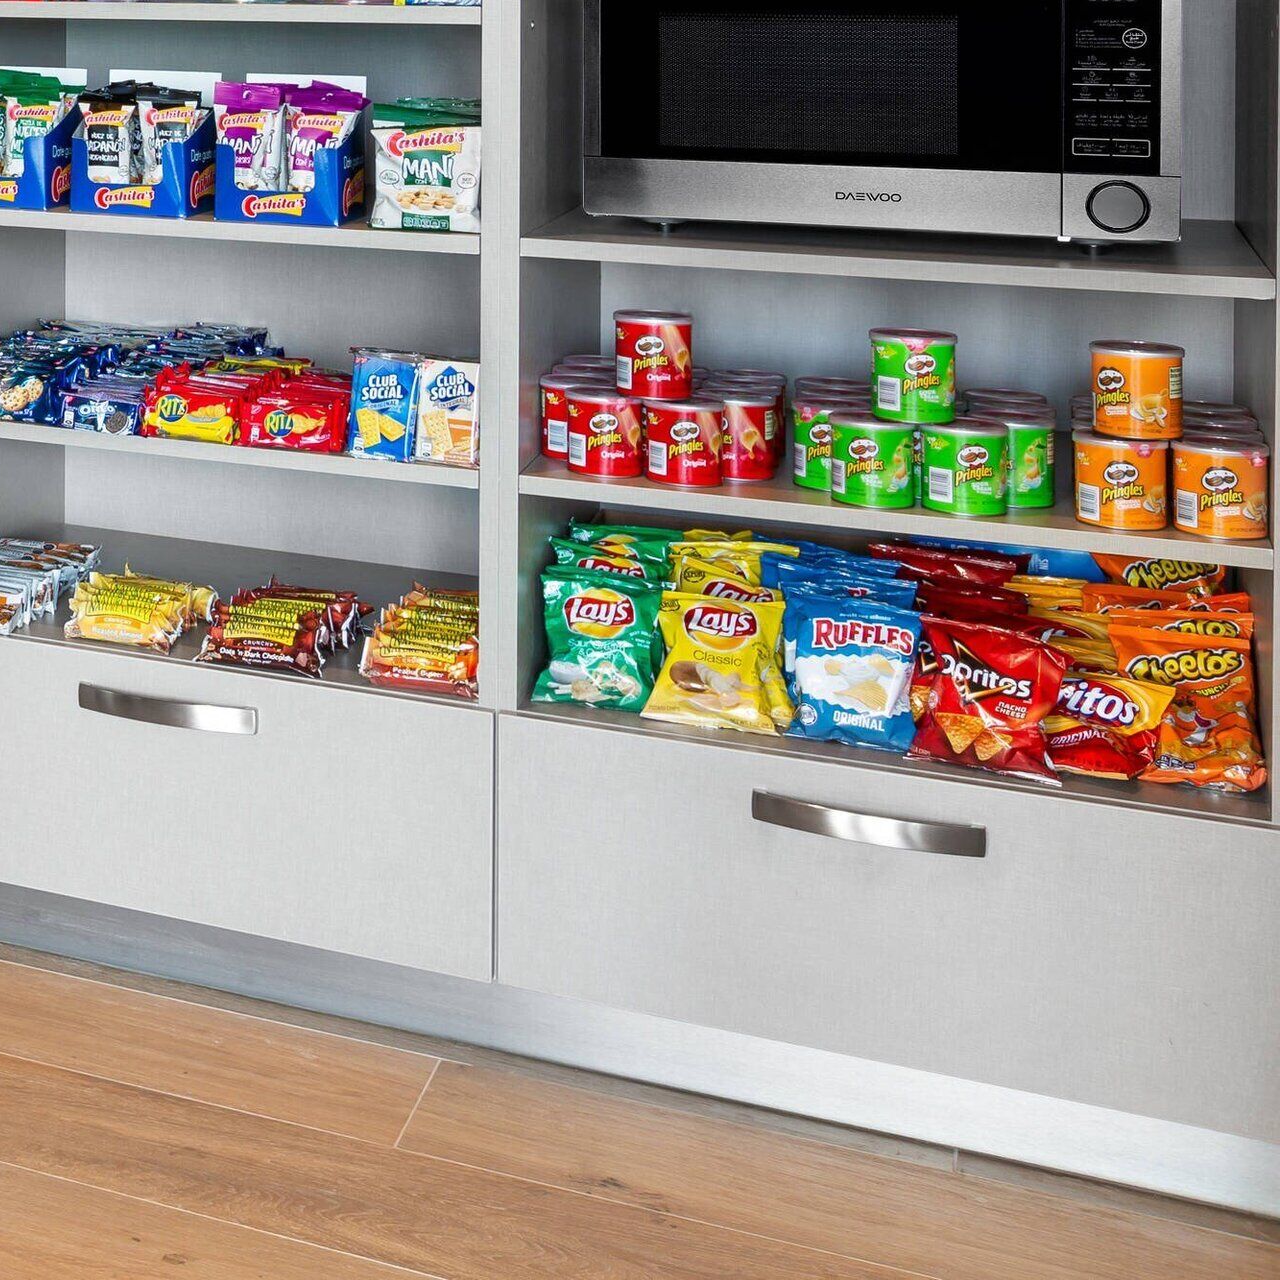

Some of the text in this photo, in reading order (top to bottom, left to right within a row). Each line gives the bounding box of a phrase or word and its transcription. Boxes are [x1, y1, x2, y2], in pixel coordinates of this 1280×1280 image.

[387, 130, 466, 157] Cashita's
[403, 153, 456, 180] MANÍ
[95, 187, 155, 209] Cashita's
[242, 194, 306, 218] Cashita's
[835, 191, 902, 203] DAEWOO
[633, 353, 669, 374] Pringles
[367, 374, 398, 387] CLUB
[436, 372, 466, 385] CLUB
[902, 373, 941, 395] Pringles
[157, 397, 186, 418] RITZ
[1096, 390, 1130, 409] Pringles
[266, 413, 293, 434] RITZ
[587, 431, 623, 452] Pringles
[668, 439, 704, 459] Pringles
[807, 443, 831, 462] Pring
[846, 458, 884, 478] Pringles
[954, 465, 993, 487] Pringles
[1101, 483, 1144, 504] Pringles
[1200, 489, 1244, 511] Pringles
[569, 596, 630, 626] Lay's
[688, 607, 752, 637] Lay's
[814, 618, 913, 655] RUFFLES
[692, 649, 742, 667] Classic
[1130, 649, 1242, 686] Cheetos
[1058, 681, 1140, 726] ritos
[832, 710, 885, 732] ORIGINAL
